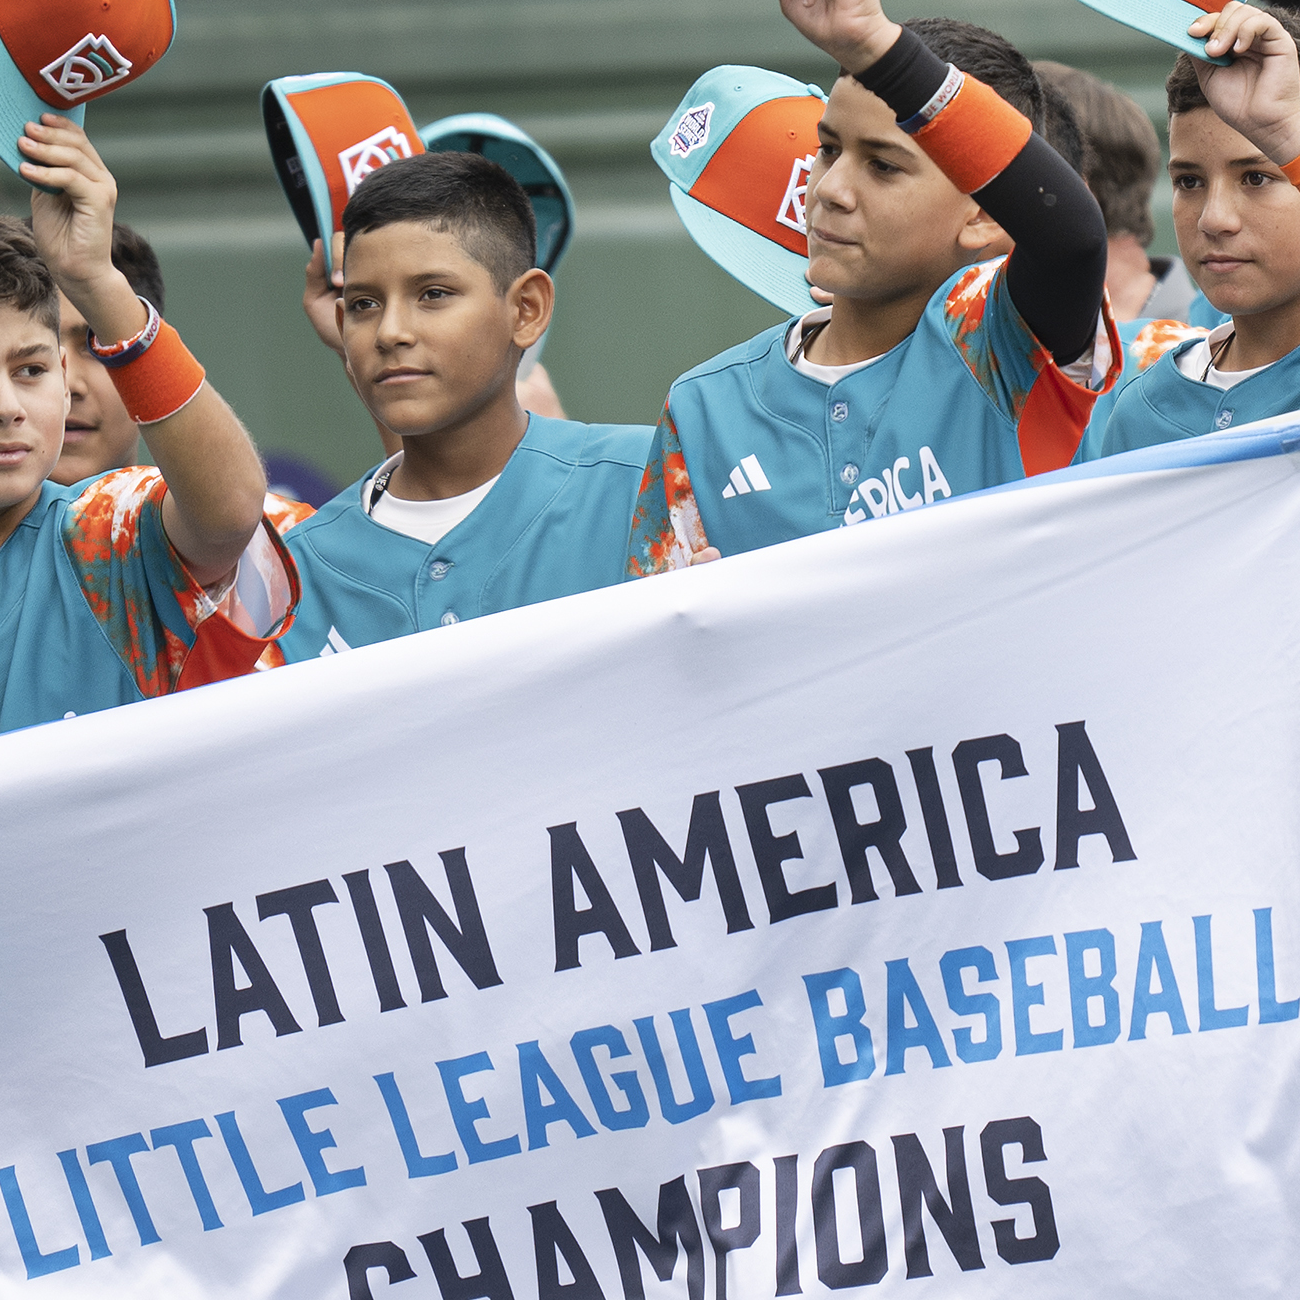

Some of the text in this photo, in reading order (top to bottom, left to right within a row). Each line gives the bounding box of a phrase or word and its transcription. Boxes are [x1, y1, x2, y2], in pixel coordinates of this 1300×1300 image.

[678, 123, 699, 146] SERIES
[683, 114, 705, 139] WORLD
[843, 445, 952, 527] ERICA
[98, 719, 1138, 1068] LATIN AMERICA
[373, 989, 782, 1179] LEAGUE
